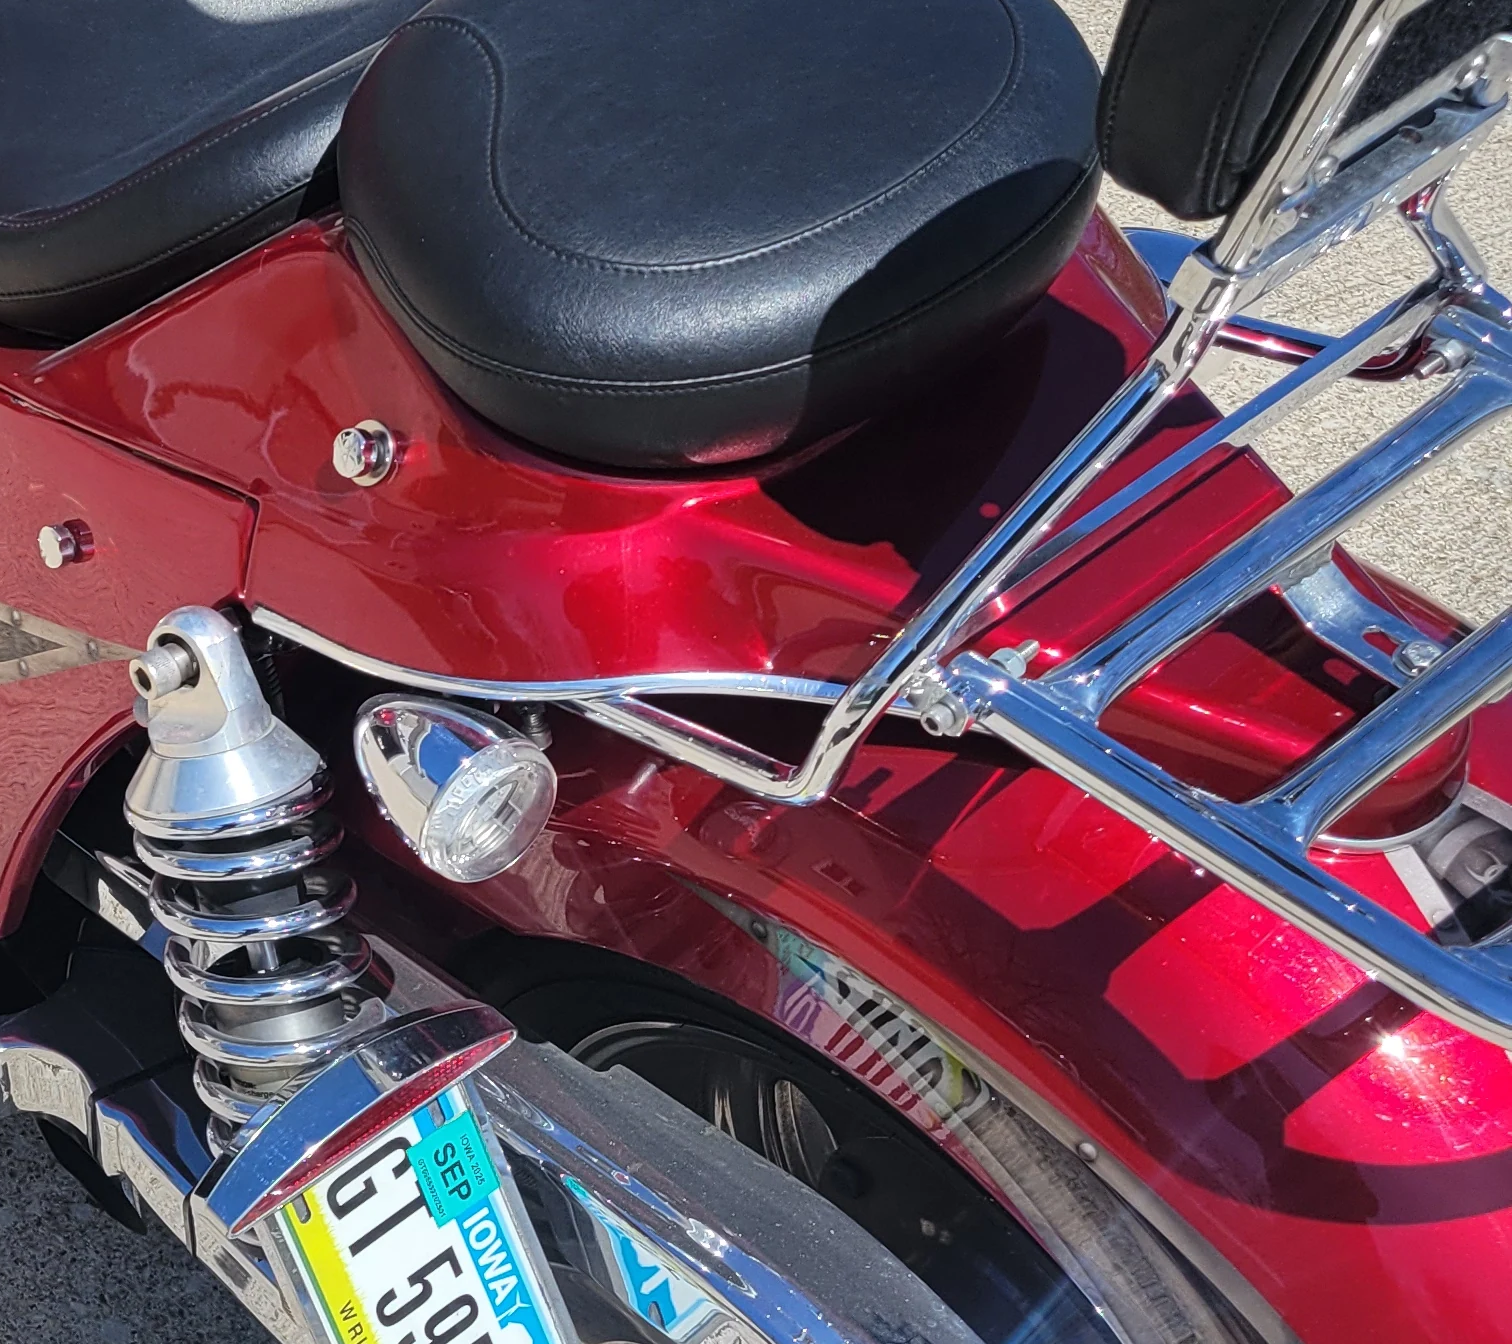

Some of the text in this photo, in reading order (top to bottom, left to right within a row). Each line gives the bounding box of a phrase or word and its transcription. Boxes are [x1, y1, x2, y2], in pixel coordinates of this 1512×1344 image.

[433, 1142, 472, 1201] SEP
[458, 1134, 476, 1163] IOWA
[326, 1136, 443, 1257] GT
[463, 1207, 520, 1307] IOWA
